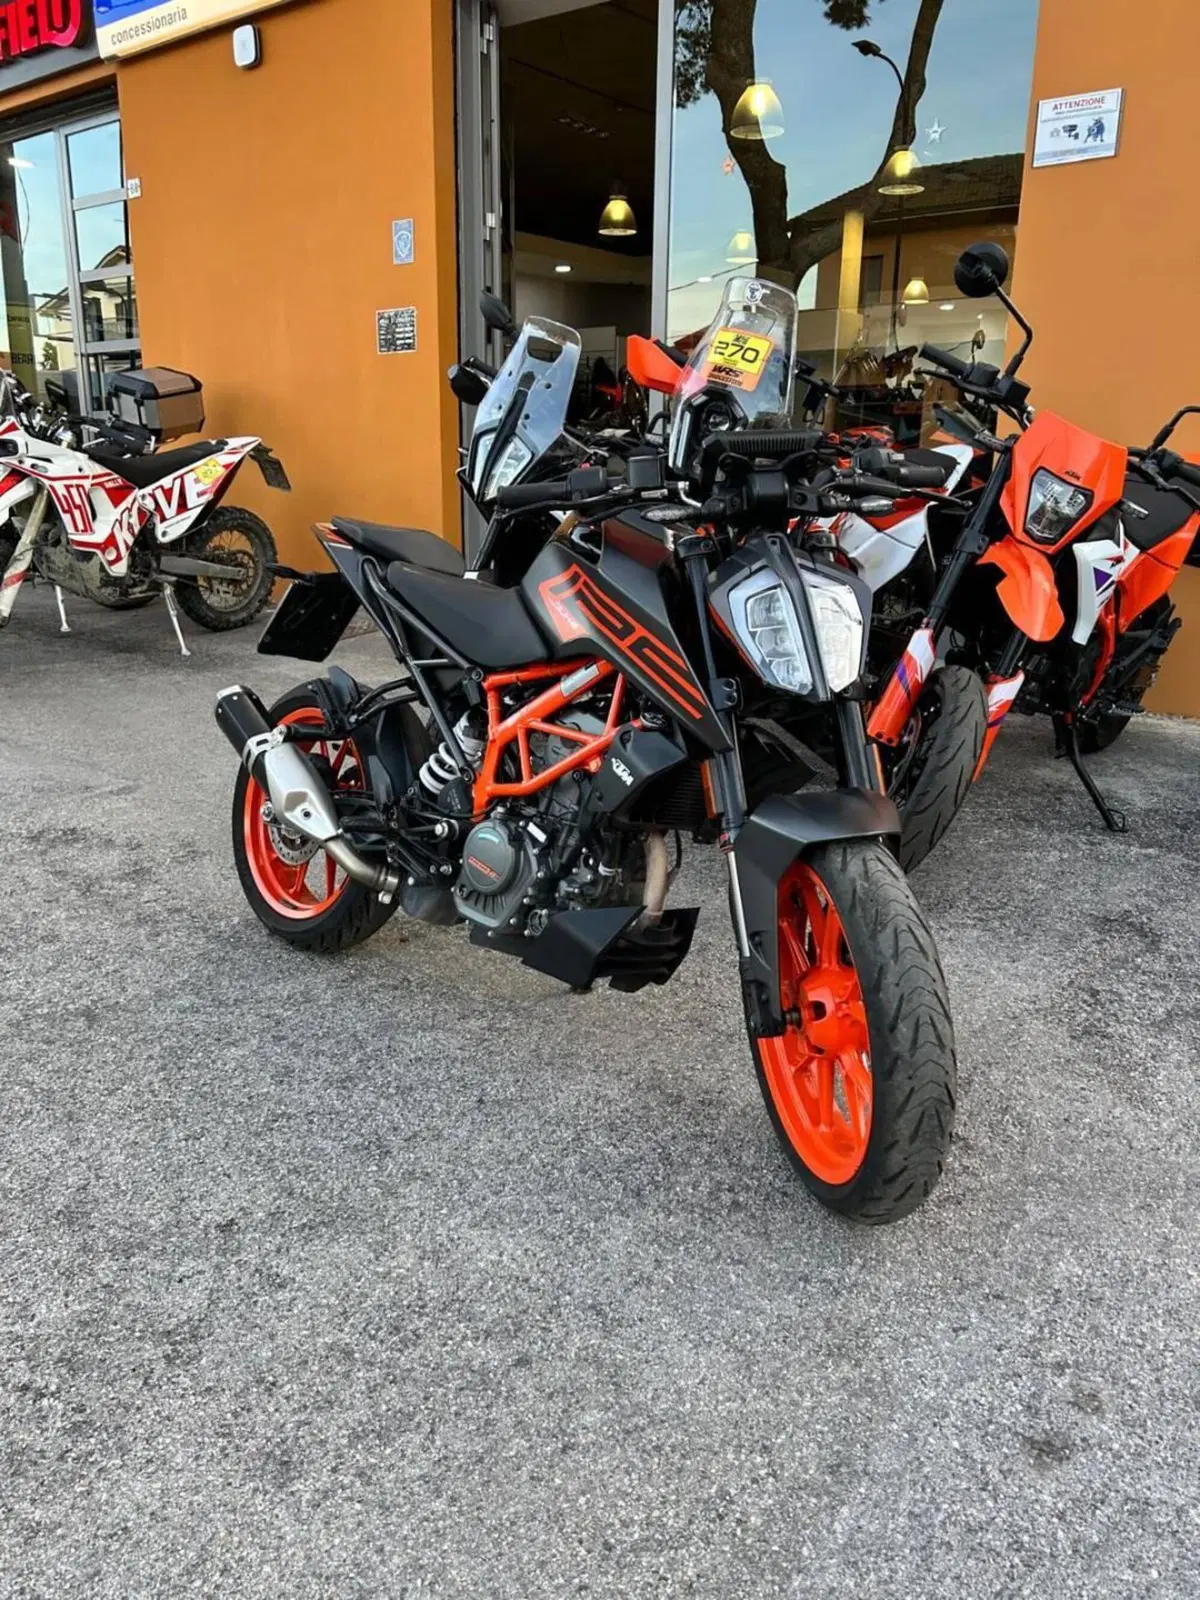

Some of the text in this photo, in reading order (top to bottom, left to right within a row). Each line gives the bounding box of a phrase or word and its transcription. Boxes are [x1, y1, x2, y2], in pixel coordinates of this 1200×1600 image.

[110, 6, 188, 46] concessionaria
[1052, 97, 1106, 112] ATTENZIONE
[714, 340, 760, 363] 270
[611, 757, 634, 786] KTM
